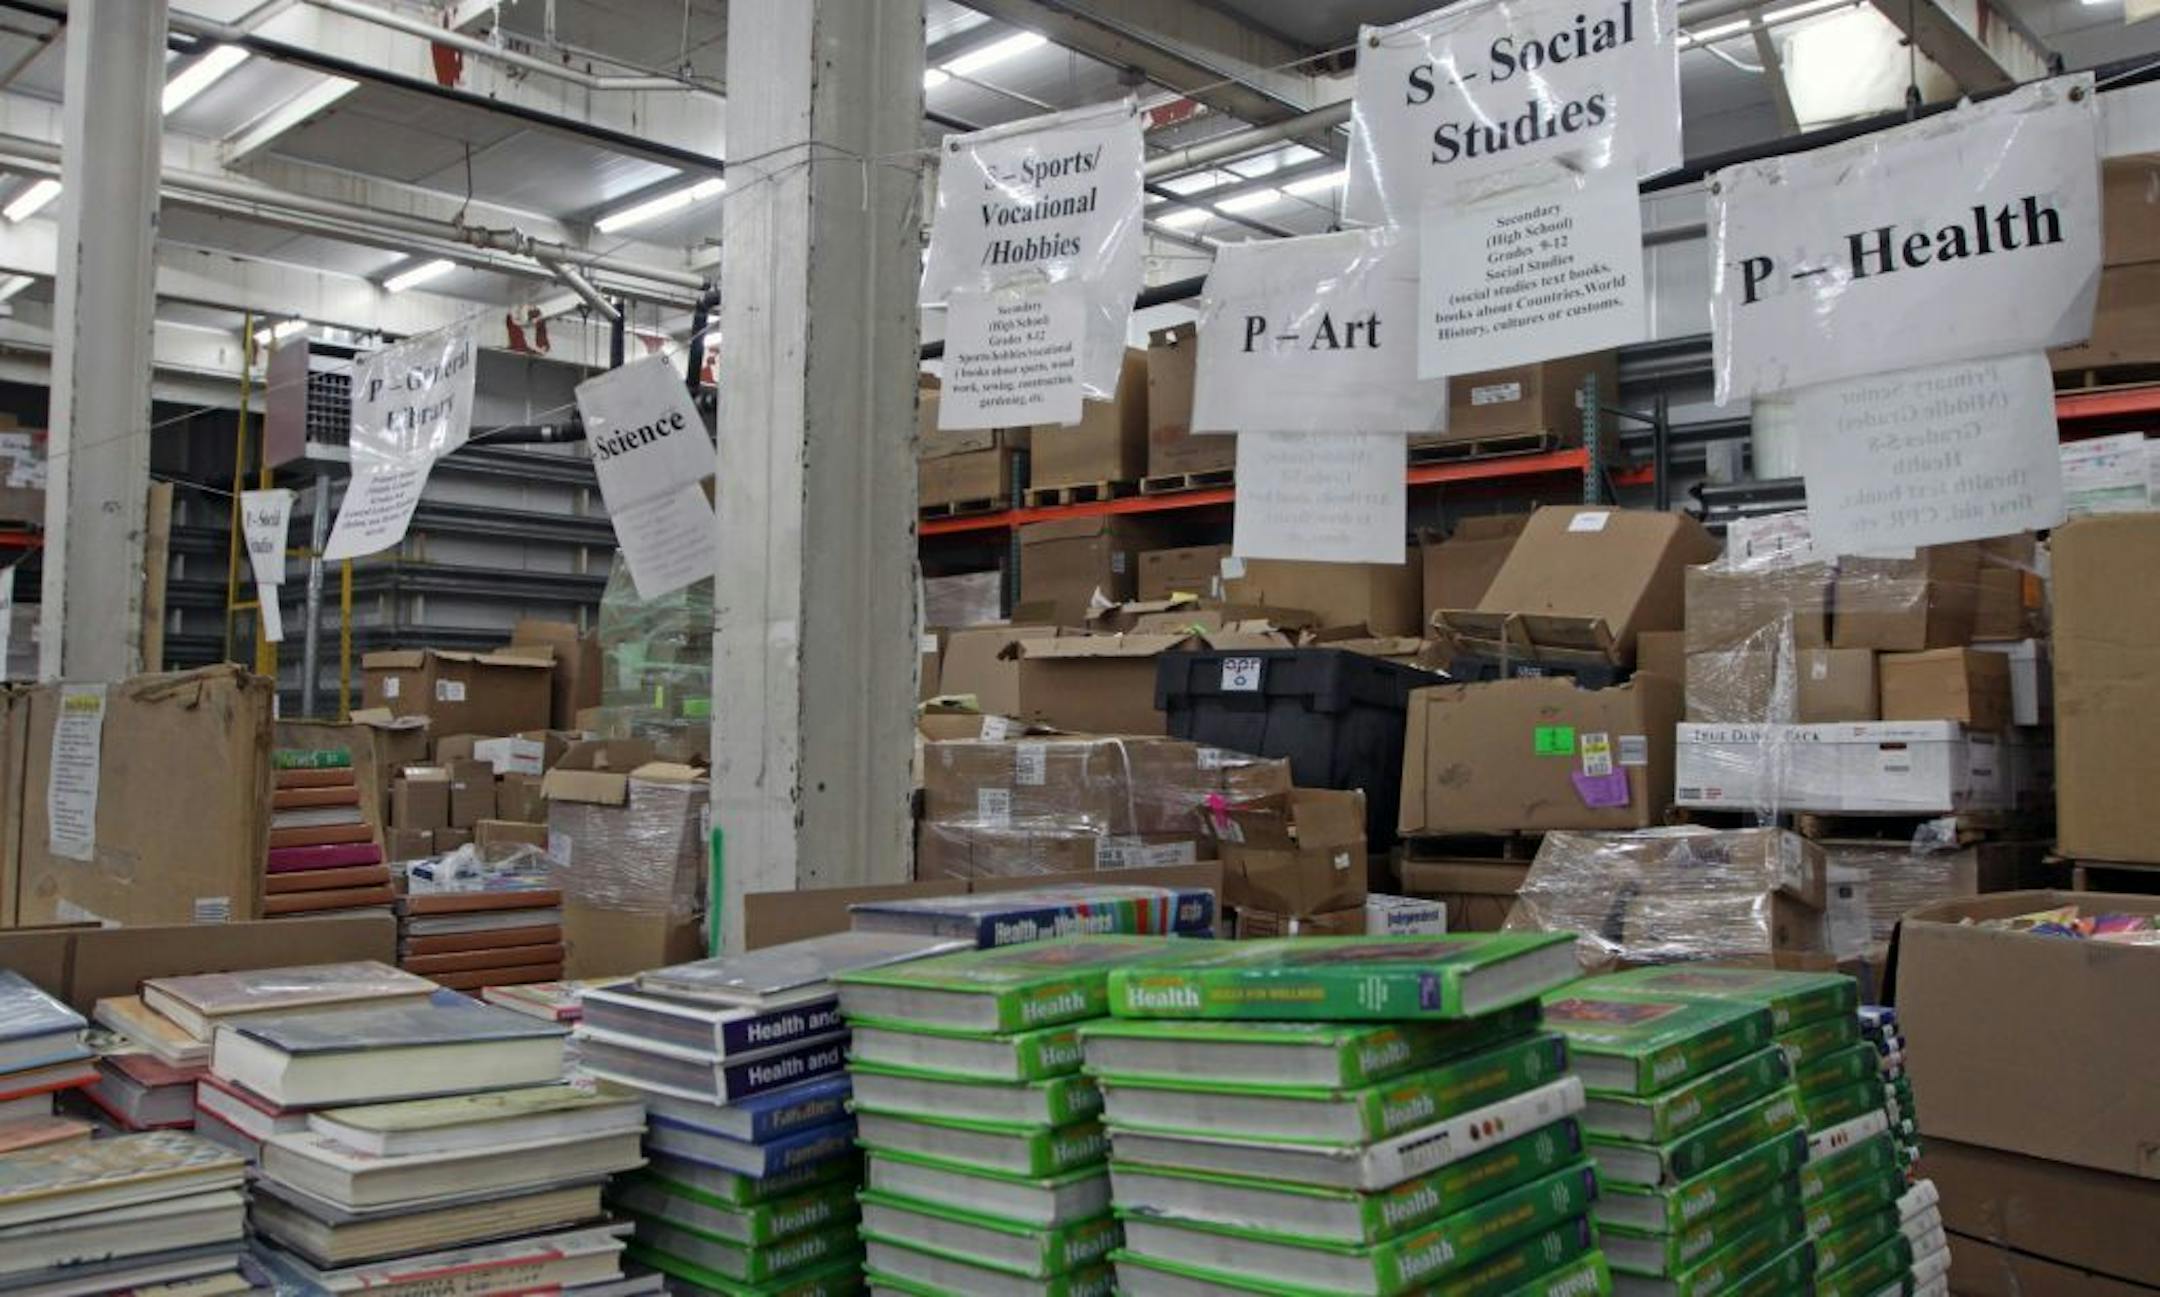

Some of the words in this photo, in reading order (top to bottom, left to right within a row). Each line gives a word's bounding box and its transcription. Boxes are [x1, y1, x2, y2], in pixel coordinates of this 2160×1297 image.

[1406, 64, 1436, 106] S
[1490, 0, 1634, 84] Social
[1431, 92, 1606, 165] Studies
[1021, 144, 1102, 188] Sports/
[981, 187, 1097, 227] Vocational
[1496, 204, 1561, 228] Secondary
[981, 232, 1081, 266] /Hobbies
[1487, 246, 1534, 264] Grades
[1740, 256, 1774, 306] P
[1845, 195, 2064, 280] Health
[1485, 263, 1524, 281] Social
[1527, 254, 1575, 272] Studies
[1493, 280, 1538, 297] studies
[1541, 272, 1566, 287] text
[1476, 301, 1513, 318] about
[1492, 313, 1545, 332] cultures
[1243, 315, 1267, 353] P
[1309, 311, 1382, 351] Art
[368, 378, 384, 403] P
[595, 411, 686, 461] Science
[994, 919, 1037, 946] Health
[1023, 993, 1085, 1021] Health
[1127, 983, 1200, 1009] Health
[747, 1014, 805, 1043] Health
[747, 1058, 804, 1086] Health
[808, 1047, 839, 1071] and
[1359, 1040, 1411, 1072] Health
[1383, 1094, 1435, 1134] Health
[1383, 1186, 1440, 1224] Health
[1399, 1240, 1456, 1279] Health
